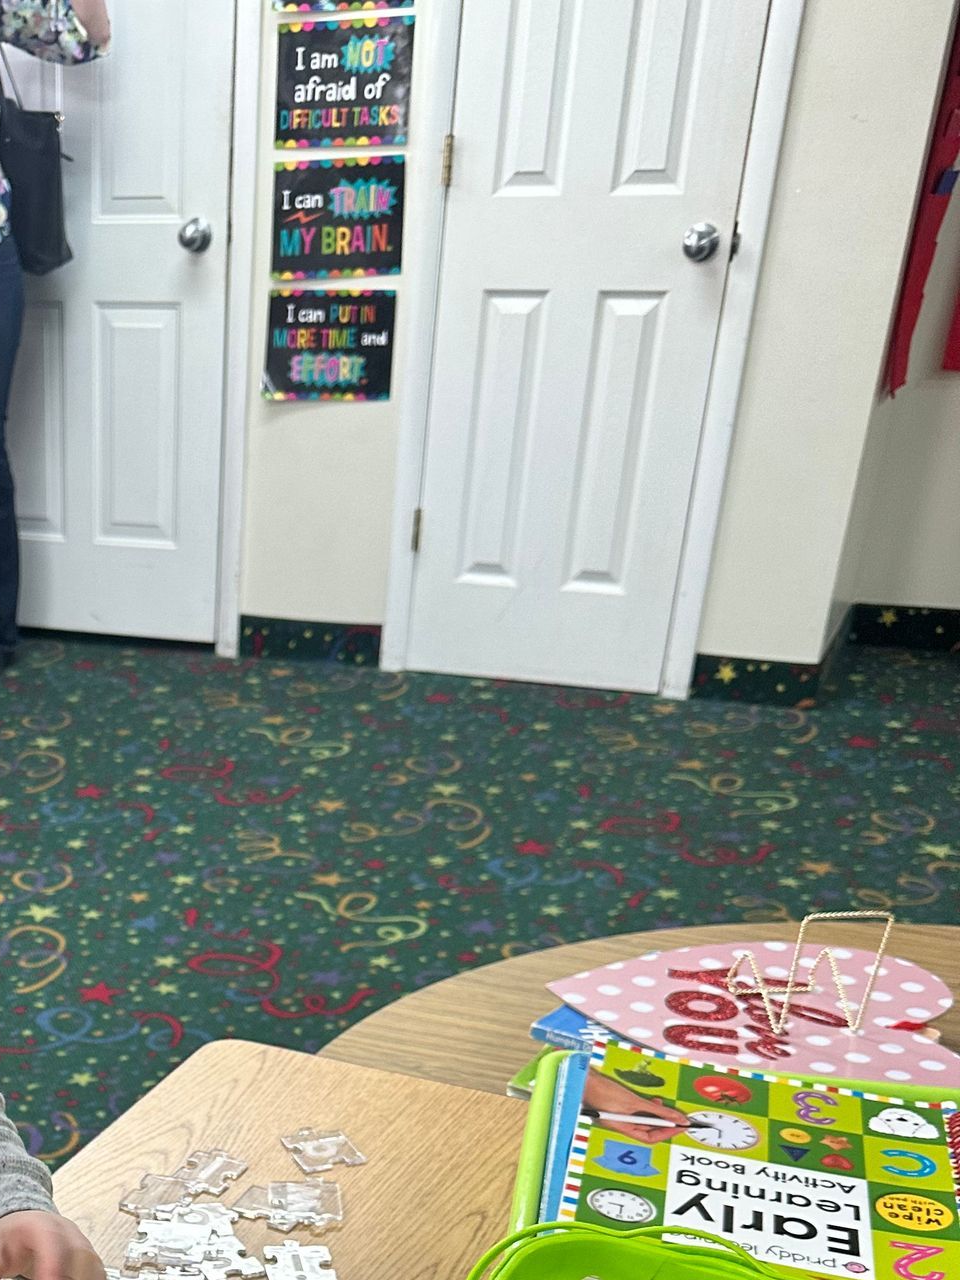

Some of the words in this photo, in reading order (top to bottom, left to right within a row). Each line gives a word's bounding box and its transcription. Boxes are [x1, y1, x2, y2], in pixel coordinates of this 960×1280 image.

[295, 47, 306, 70] I
[310, 52, 339, 69] am
[347, 37, 390, 67] NOT
[294, 76, 357, 102] afraid
[364, 73, 391, 99] of
[280, 107, 349, 130] DIFFICULT
[282, 190, 291, 210] I
[295, 195, 324, 209] can
[329, 184, 392, 214] TRAIN
[280, 227, 316, 257] MY
[321, 224, 393, 254] BRAIN.
[286, 303, 296, 323] I
[298, 308, 326, 323] can
[330, 304, 358, 324] PUT
[360, 304, 376, 324] IN
[273, 328, 317, 349] MORE
[321, 327, 358, 349] TIME
[360, 330, 388, 346] and
[662, 967, 740, 1055] YOU
[792, 1091, 838, 1125] 3
[681, 1153, 745, 1175] Book
[756, 1166, 856, 1194] Activity
[676, 1169, 861, 1221] Learning
[883, 1201, 944, 1217] clean
[672, 1192, 860, 1257] Early
[888, 1211, 942, 1227] wipe
[765, 1244, 838, 1269] priddy
